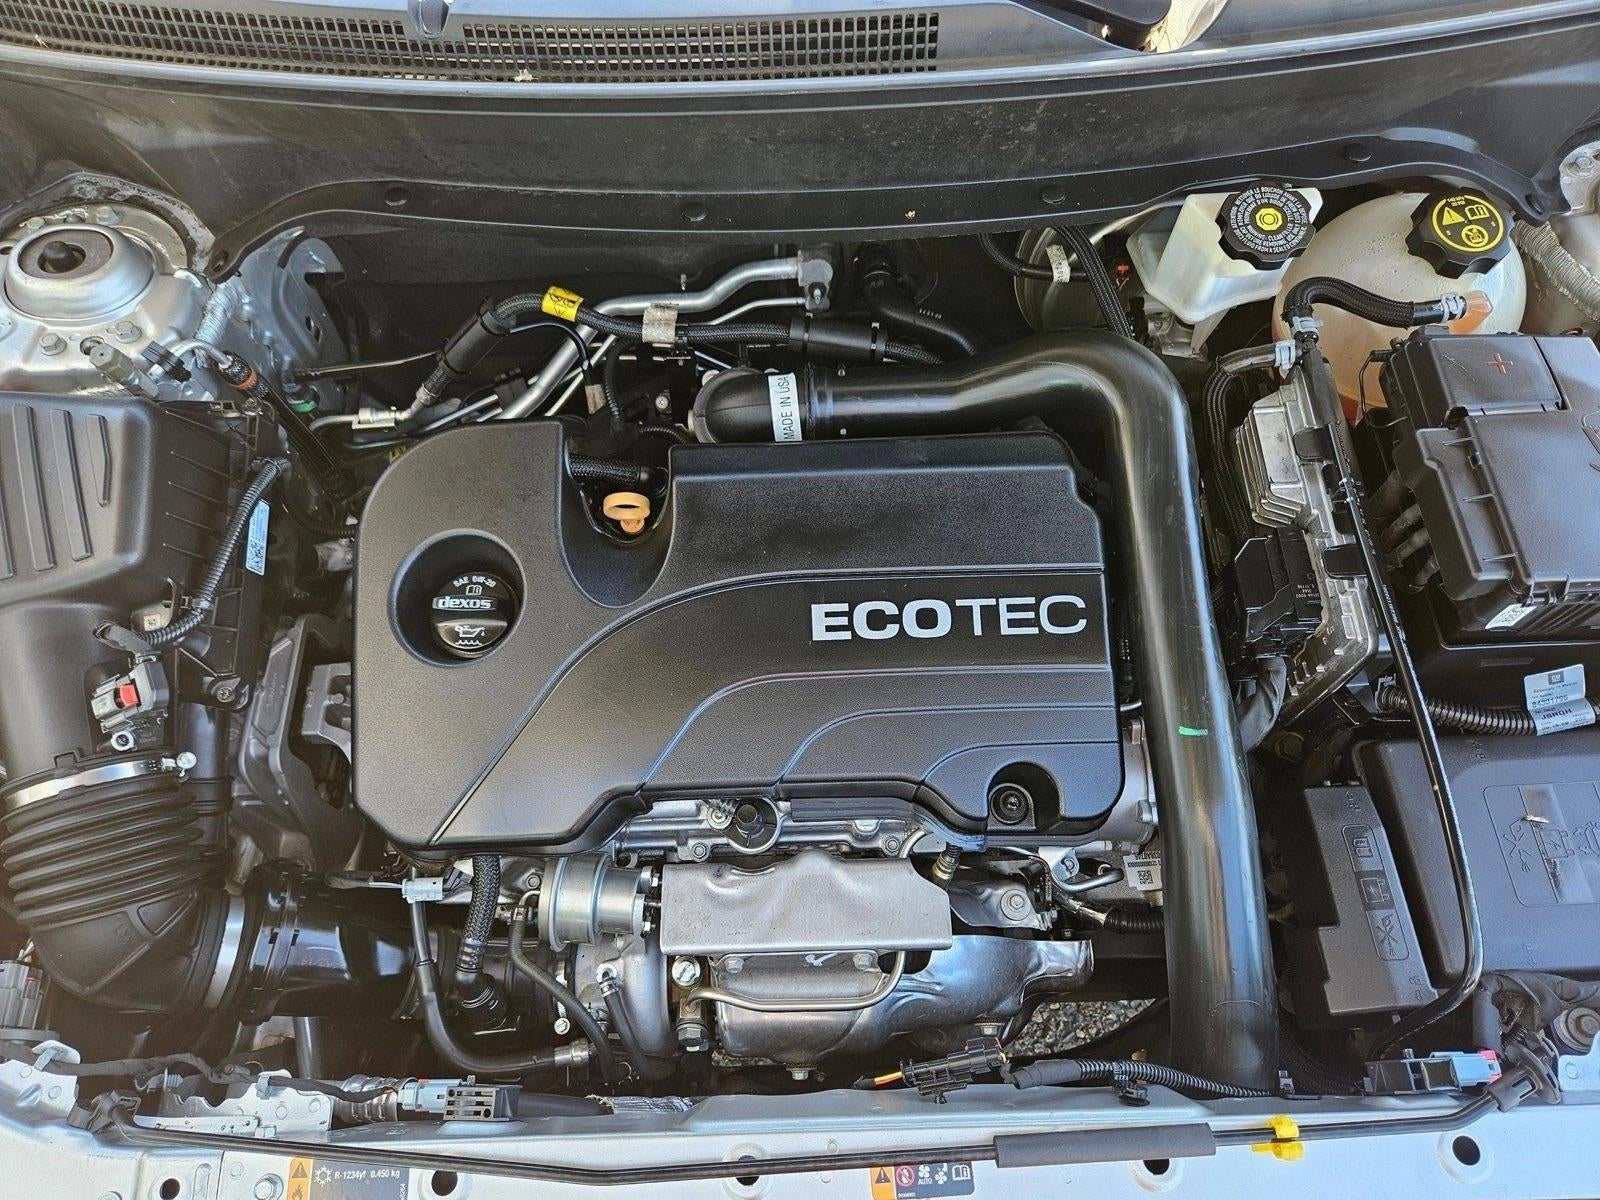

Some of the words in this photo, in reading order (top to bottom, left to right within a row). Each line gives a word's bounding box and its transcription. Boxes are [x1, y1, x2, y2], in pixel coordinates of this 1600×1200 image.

[778, 376, 790, 393] USA
[780, 397, 792, 407] IN
[781, 411, 795, 440] MADE
[453, 576, 469, 587] SAE
[472, 576, 496, 587] 0W-20
[438, 596, 493, 609] dexos
[811, 595, 1087, 641] ECOTEC
[370, 1169, 390, 1179] 0.450
[390, 1169, 400, 1179] kg
[917, 1177, 933, 1185] AUTO
